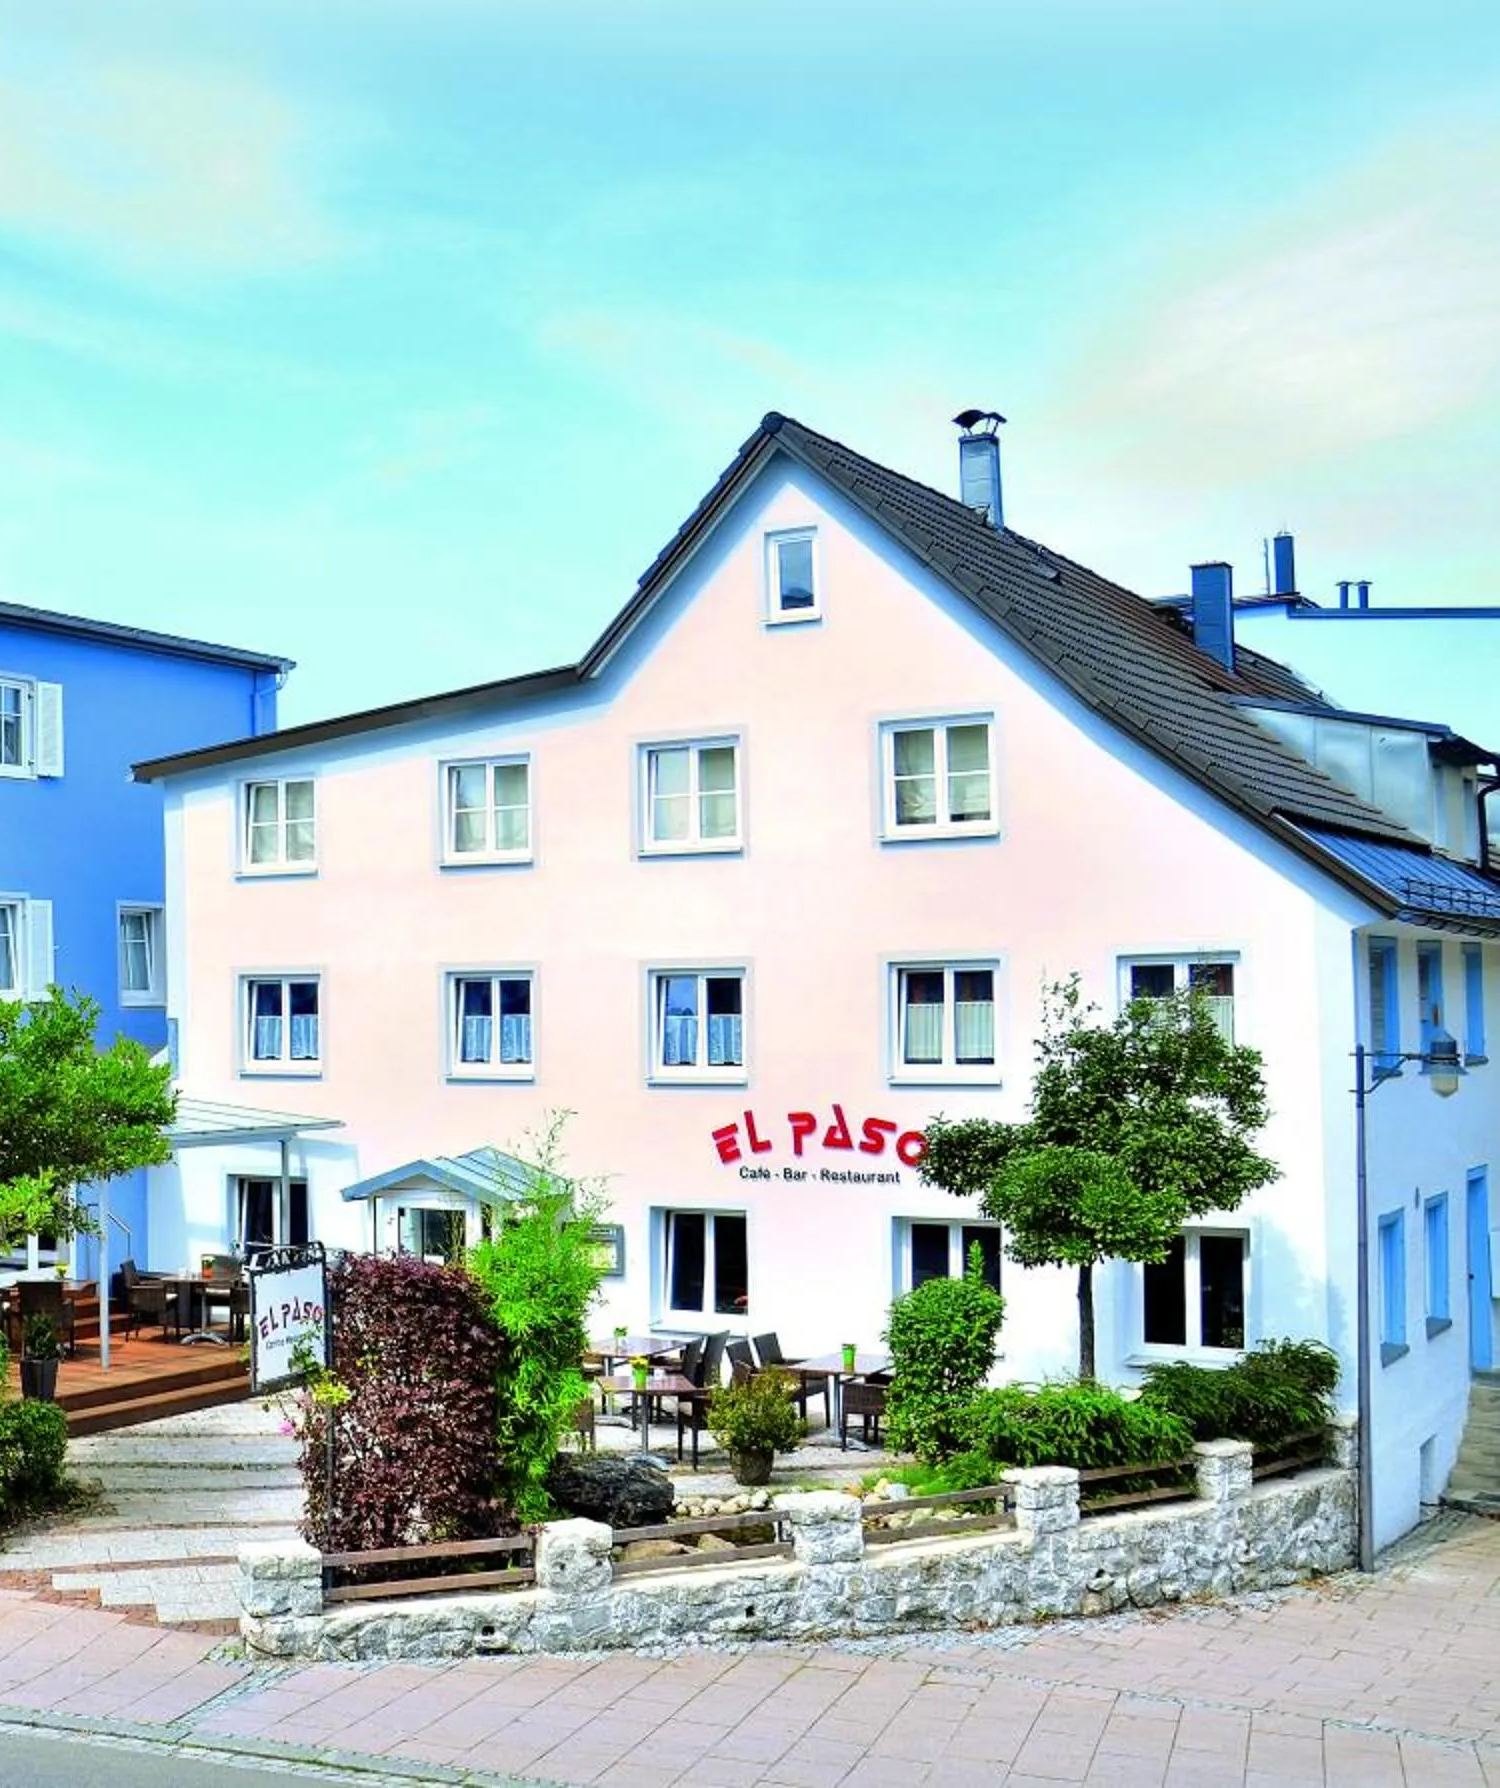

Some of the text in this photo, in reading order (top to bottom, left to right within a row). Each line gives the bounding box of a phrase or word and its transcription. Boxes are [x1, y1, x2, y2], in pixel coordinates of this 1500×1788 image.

[711, 1103, 929, 1168] EL PASO
[783, 1167, 808, 1181] Bar
[820, 1167, 901, 1184] Restaurant
[259, 1296, 324, 1339] EL PASO
